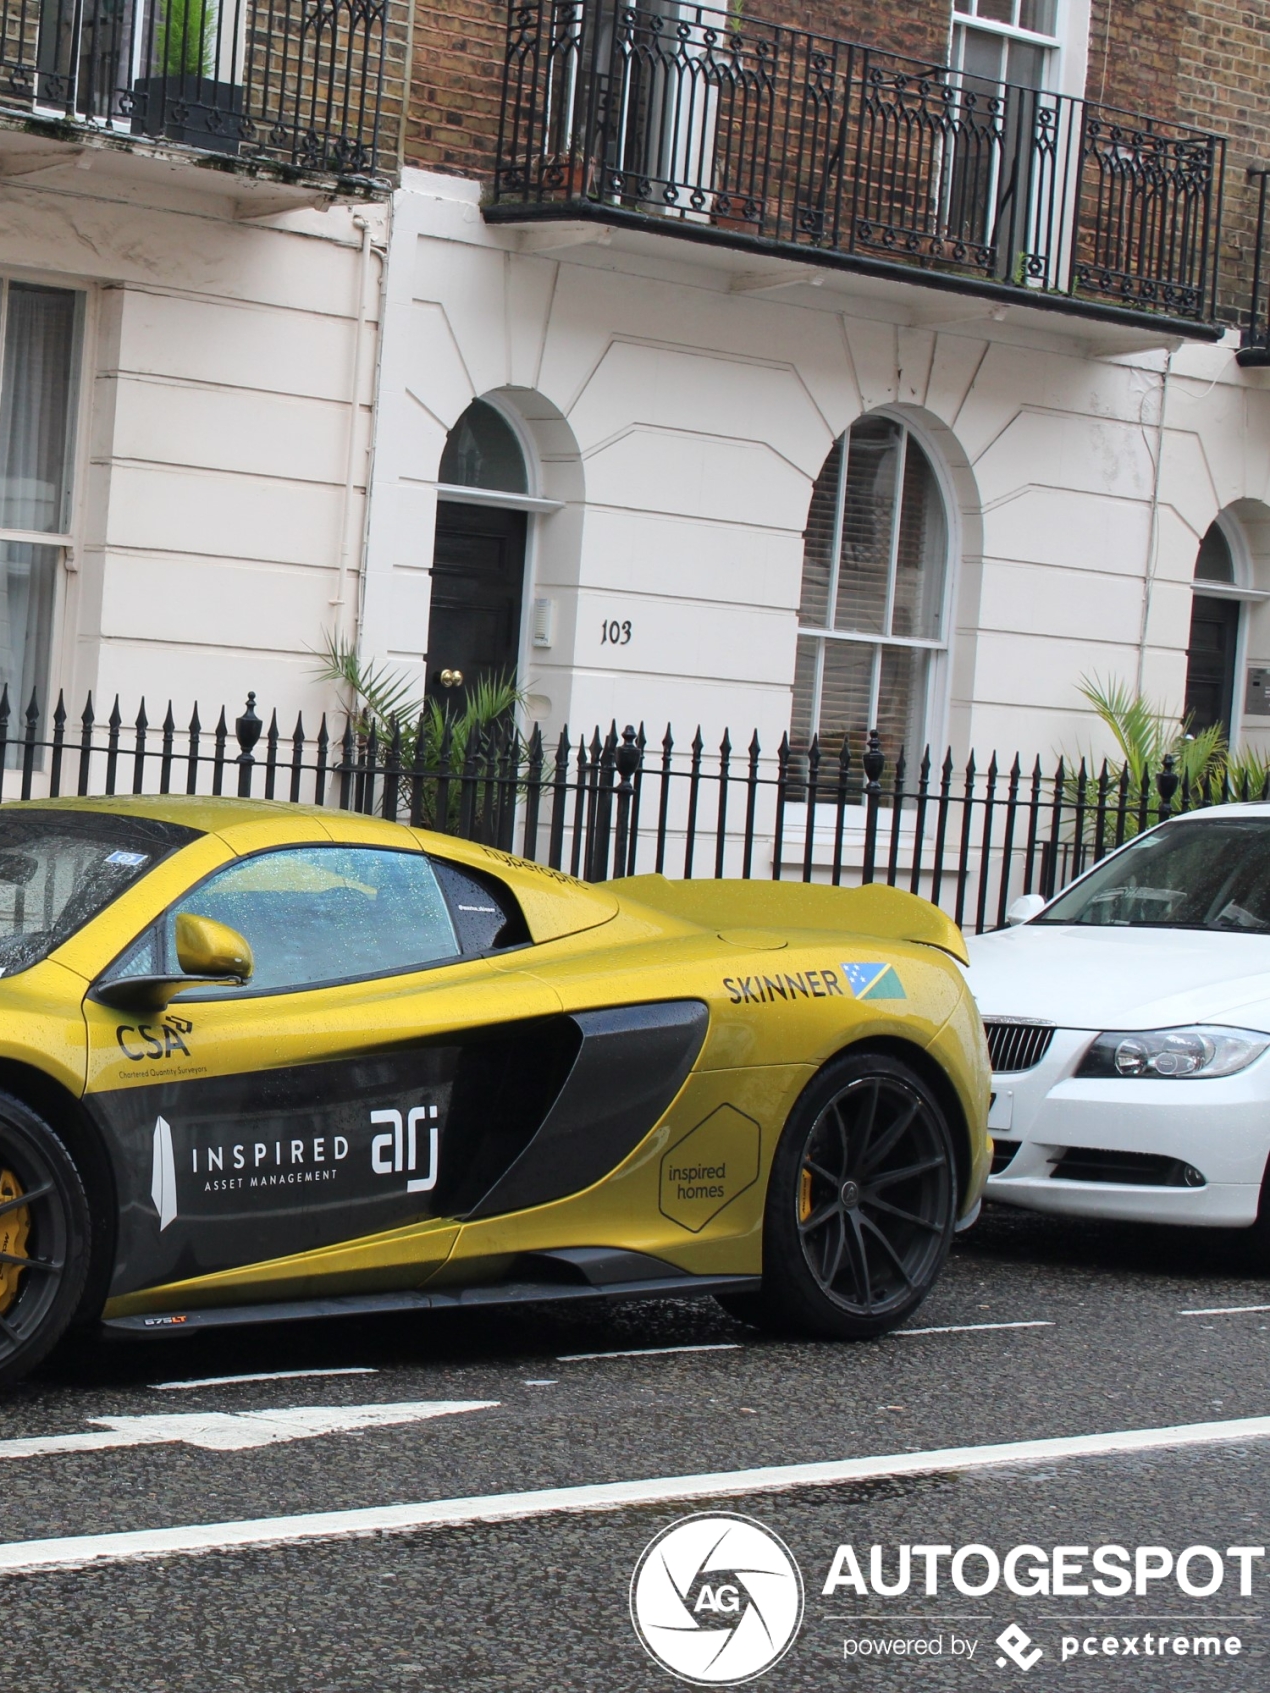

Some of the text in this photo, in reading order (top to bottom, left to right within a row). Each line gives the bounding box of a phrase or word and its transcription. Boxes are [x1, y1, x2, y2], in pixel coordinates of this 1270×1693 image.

[600, 619, 632, 645] 103
[722, 969, 843, 1004] SKINNER
[116, 1024, 191, 1061] CSA
[119, 1066, 208, 1079] Chartered Quantity Surveyors
[192, 1136, 349, 1173] INSPIRED
[204, 1169, 338, 1191] ASSET MANAGEMENT
[668, 1162, 726, 1184] inspired
[677, 1182, 724, 1200] homes
[144, 1316, 186, 1326] 675LT
